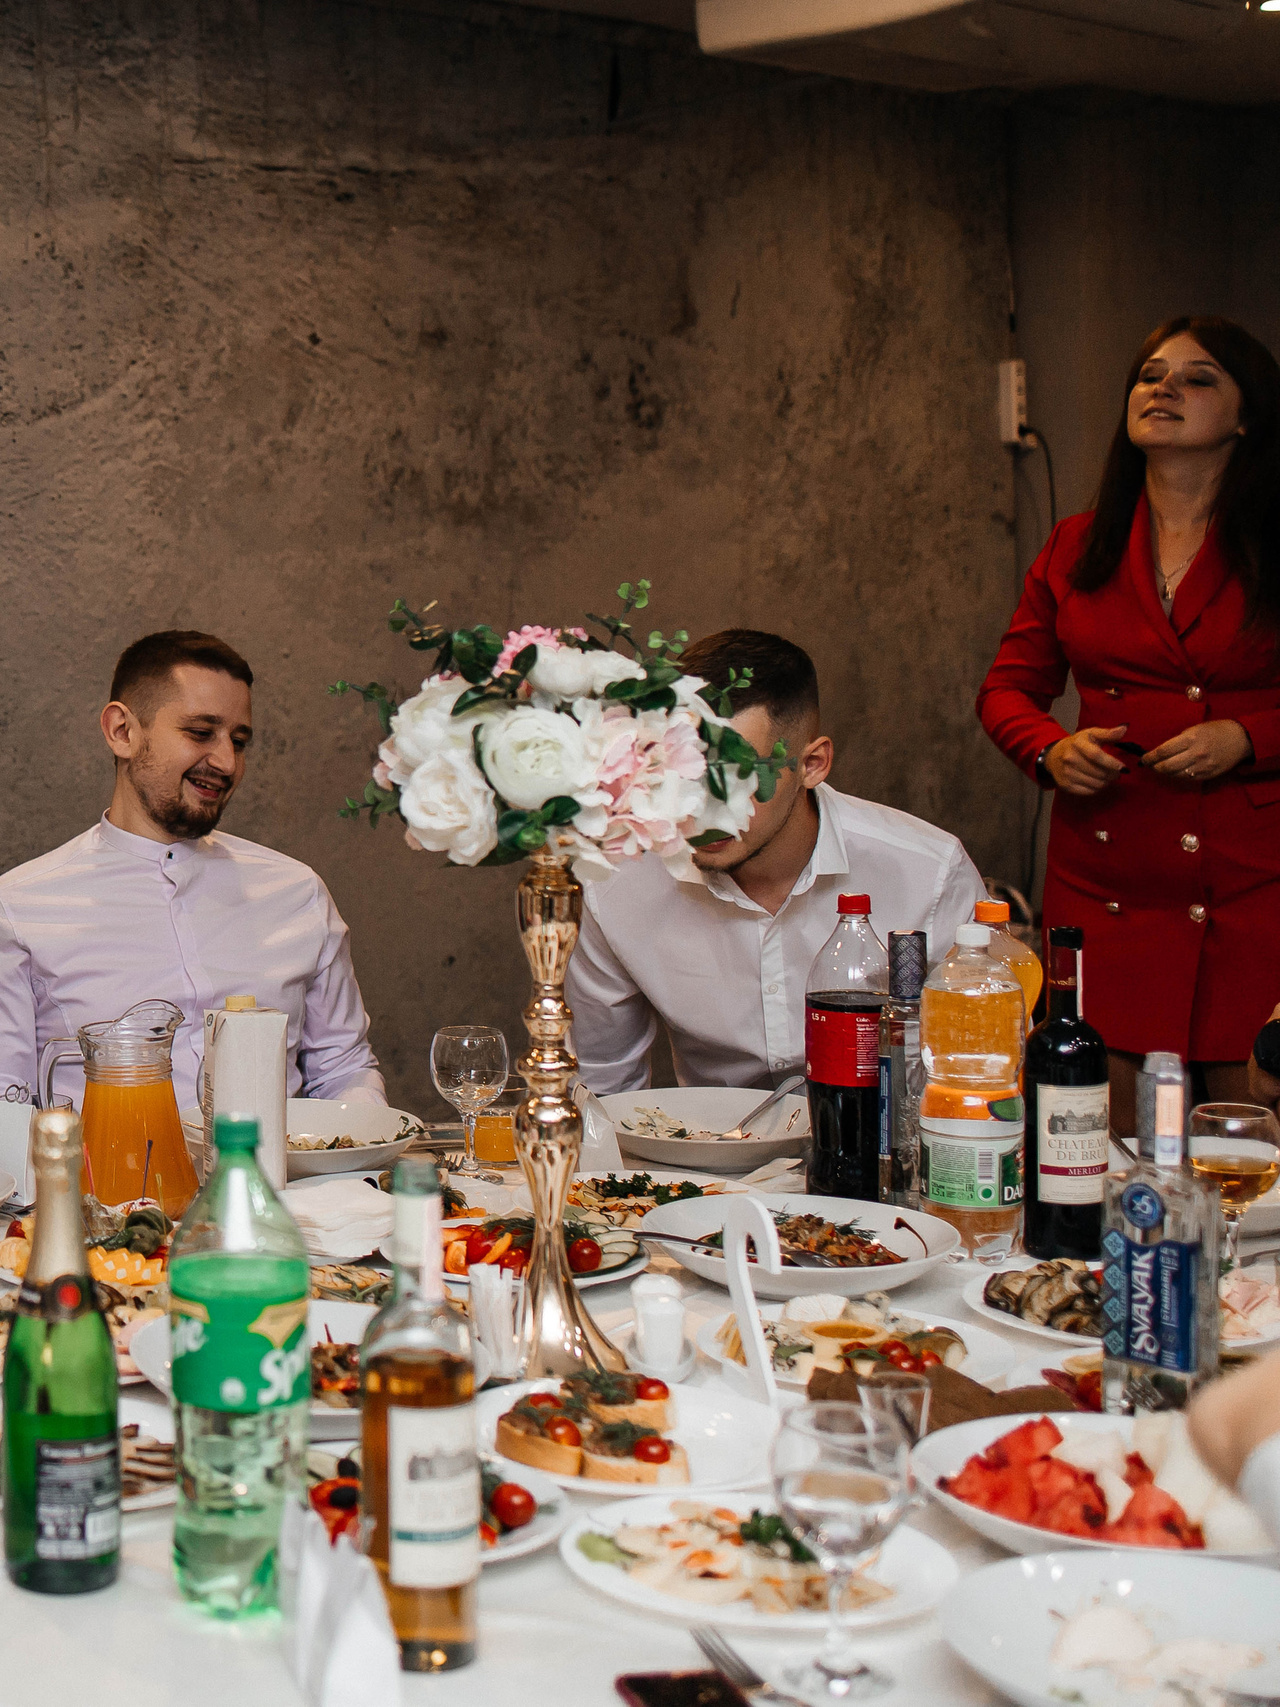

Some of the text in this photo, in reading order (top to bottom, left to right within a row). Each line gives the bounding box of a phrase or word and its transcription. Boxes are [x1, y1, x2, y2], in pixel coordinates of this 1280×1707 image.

[1055, 1150, 1076, 1161] DE
[1067, 1166, 1102, 1176] MERLOT
[1131, 1249, 1159, 1354] SVAYAK
